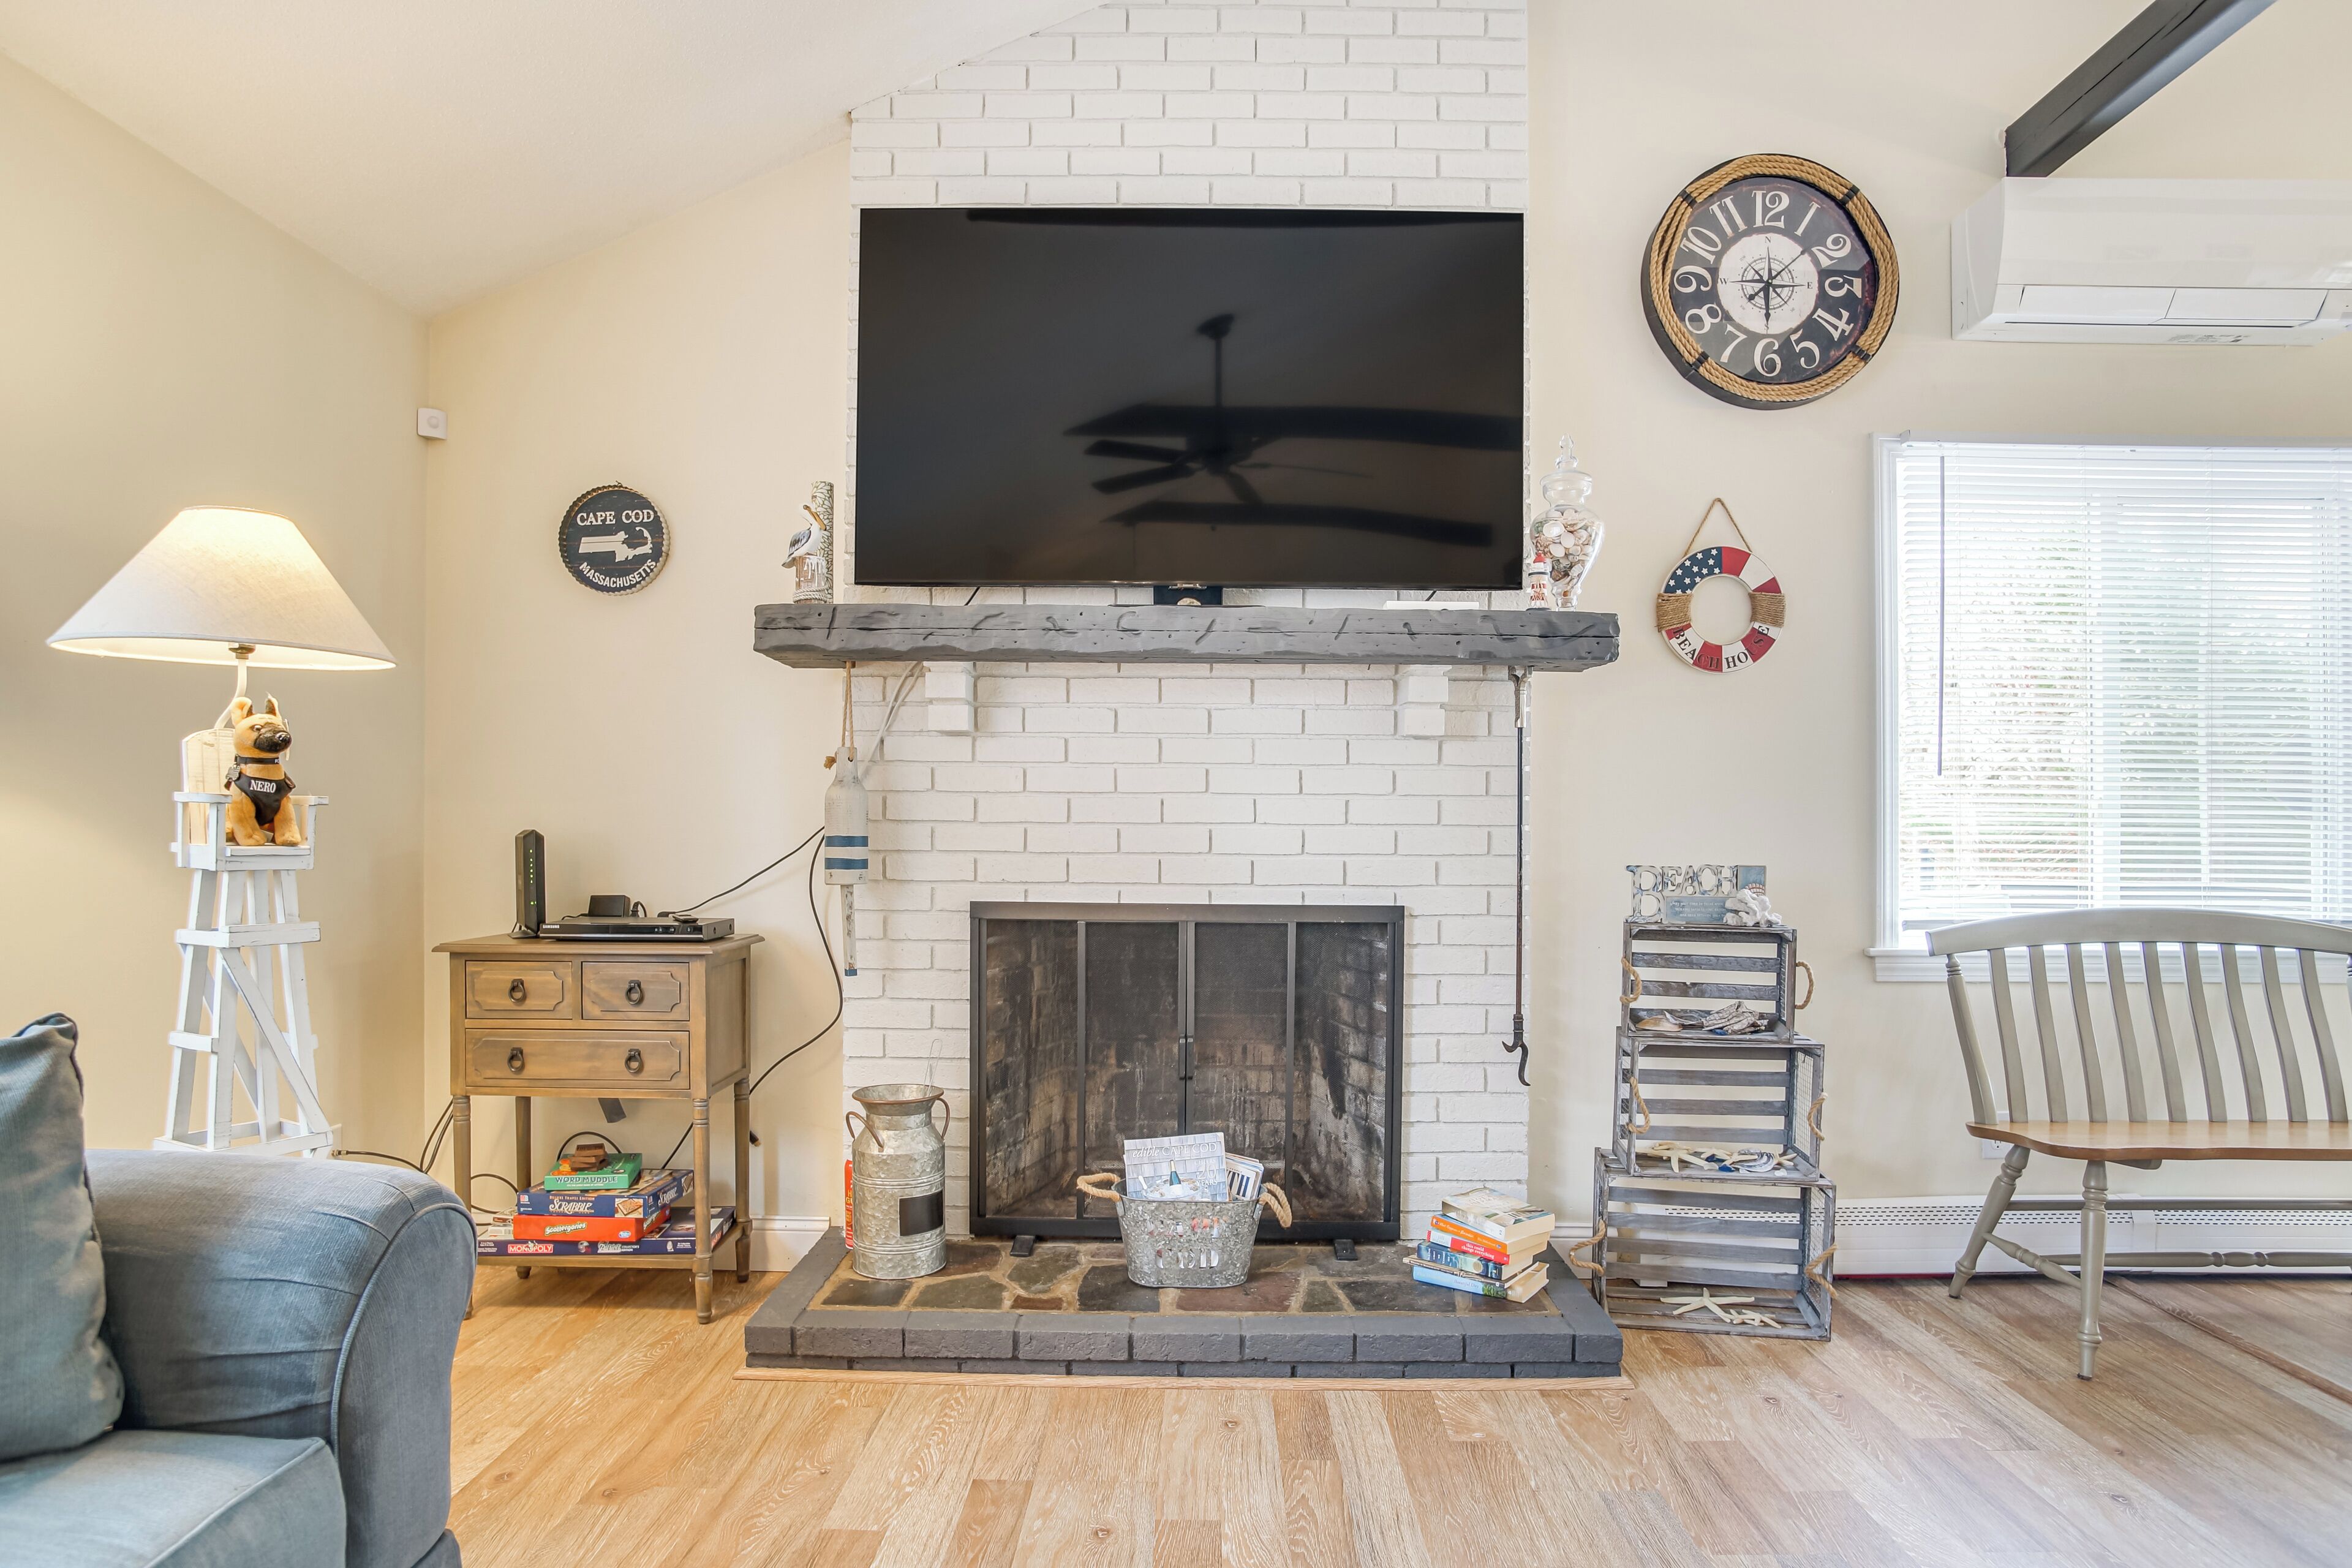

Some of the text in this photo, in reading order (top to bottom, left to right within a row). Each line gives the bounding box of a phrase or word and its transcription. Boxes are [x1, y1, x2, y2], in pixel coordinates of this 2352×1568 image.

[1709, 195, 1747, 239] 11
[1751, 190, 1790, 229] 12
[1794, 202, 1821, 237] 1
[1679, 227, 1722, 265] 10
[1811, 233, 1852, 268] 2
[1673, 265, 1712, 293] 9
[1825, 274, 1862, 298] 3
[1684, 303, 1722, 334] 8
[1812, 307, 1854, 341] 4
[1720, 324, 1748, 363] 7
[1754, 338, 1781, 377] 6
[1790, 329, 1820, 369] 5
[576, 510, 654, 526] CAPE COD
[579, 559, 656, 588] MASSACHUSETTS
[1672, 625, 1770, 669] BEACH HOUSE
[250, 780, 276, 793] NERO
[1626, 865, 1738, 922] BEACH
[1133, 1142, 1217, 1158] edible CAPE COD
[545, 1222, 587, 1235] Scattergories
[1474, 1250, 1494, 1259] everything
